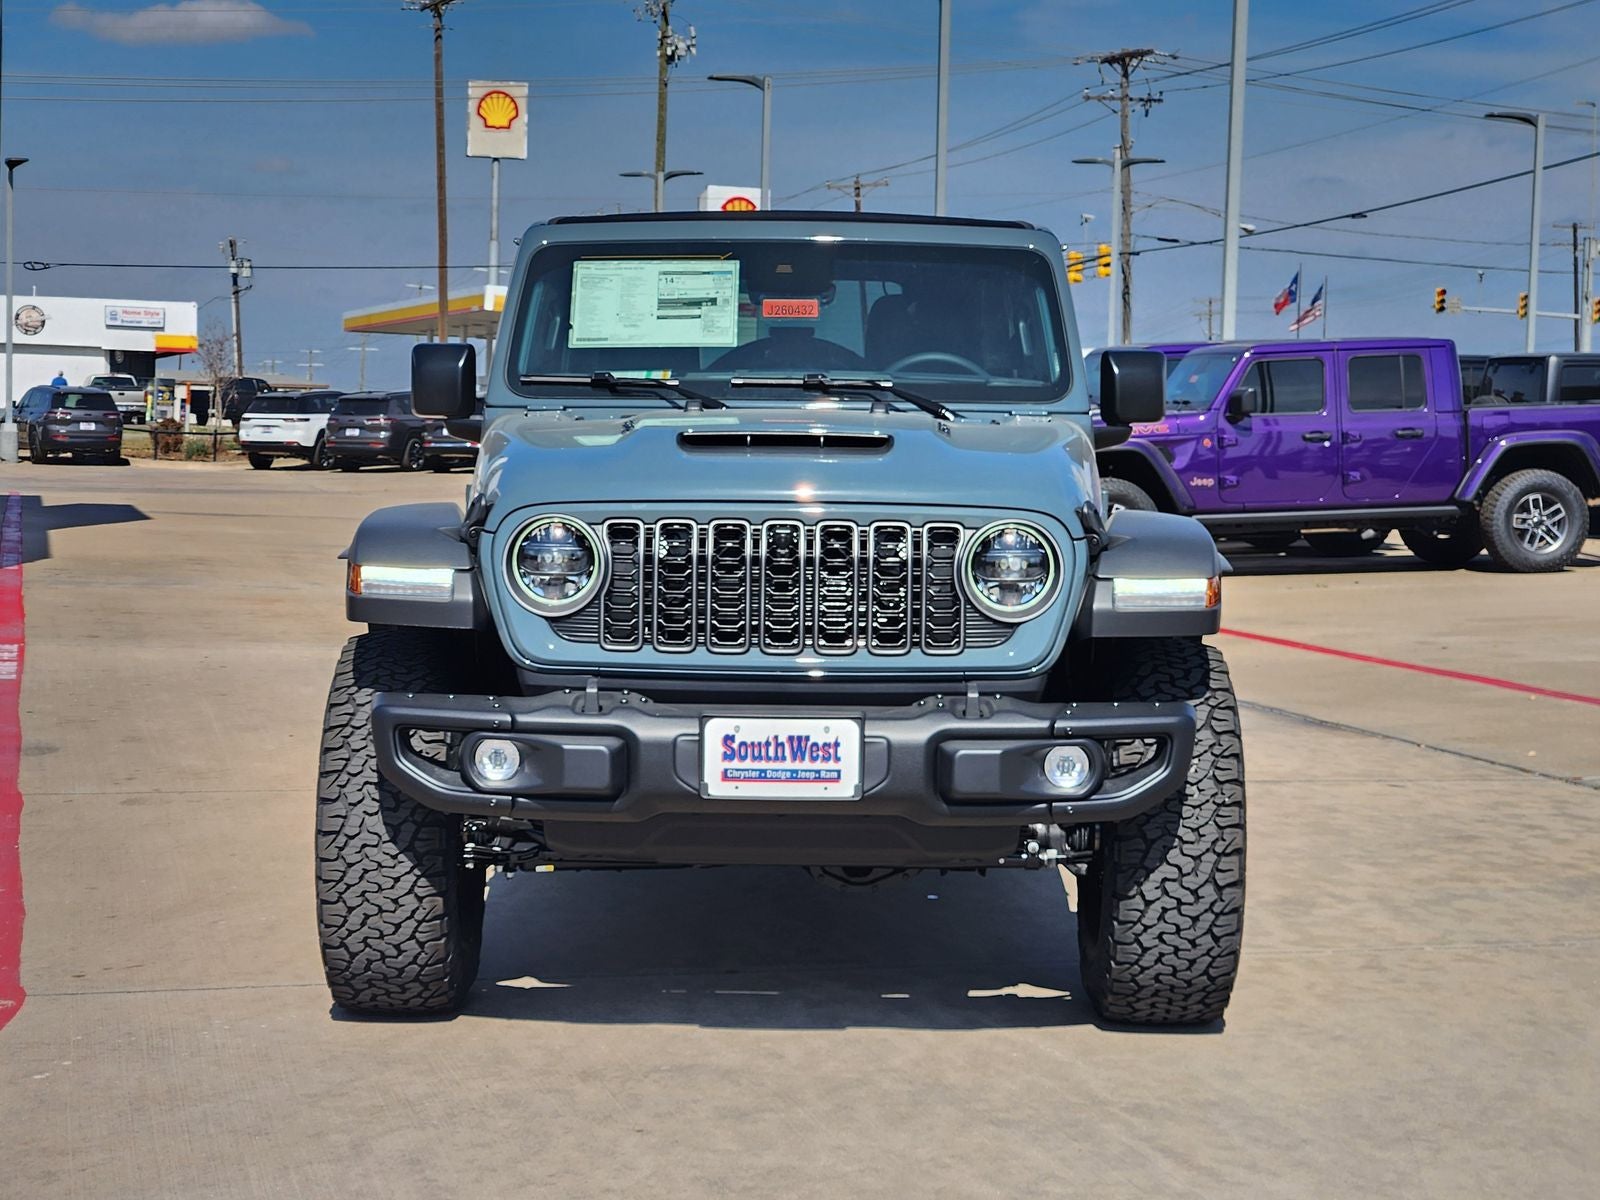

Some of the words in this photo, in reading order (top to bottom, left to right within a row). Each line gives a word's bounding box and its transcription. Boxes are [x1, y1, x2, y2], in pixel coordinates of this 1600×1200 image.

[143, 310, 160, 318] Style
[767, 304, 814, 316] J260432
[1189, 476, 1215, 488] Jeep
[721, 733, 842, 764] SouthWest
[727, 769, 760, 780] Chrysler
[766, 769, 791, 780] Dodge
[797, 770, 816, 780] Jeep
[820, 770, 838, 779] Ram
